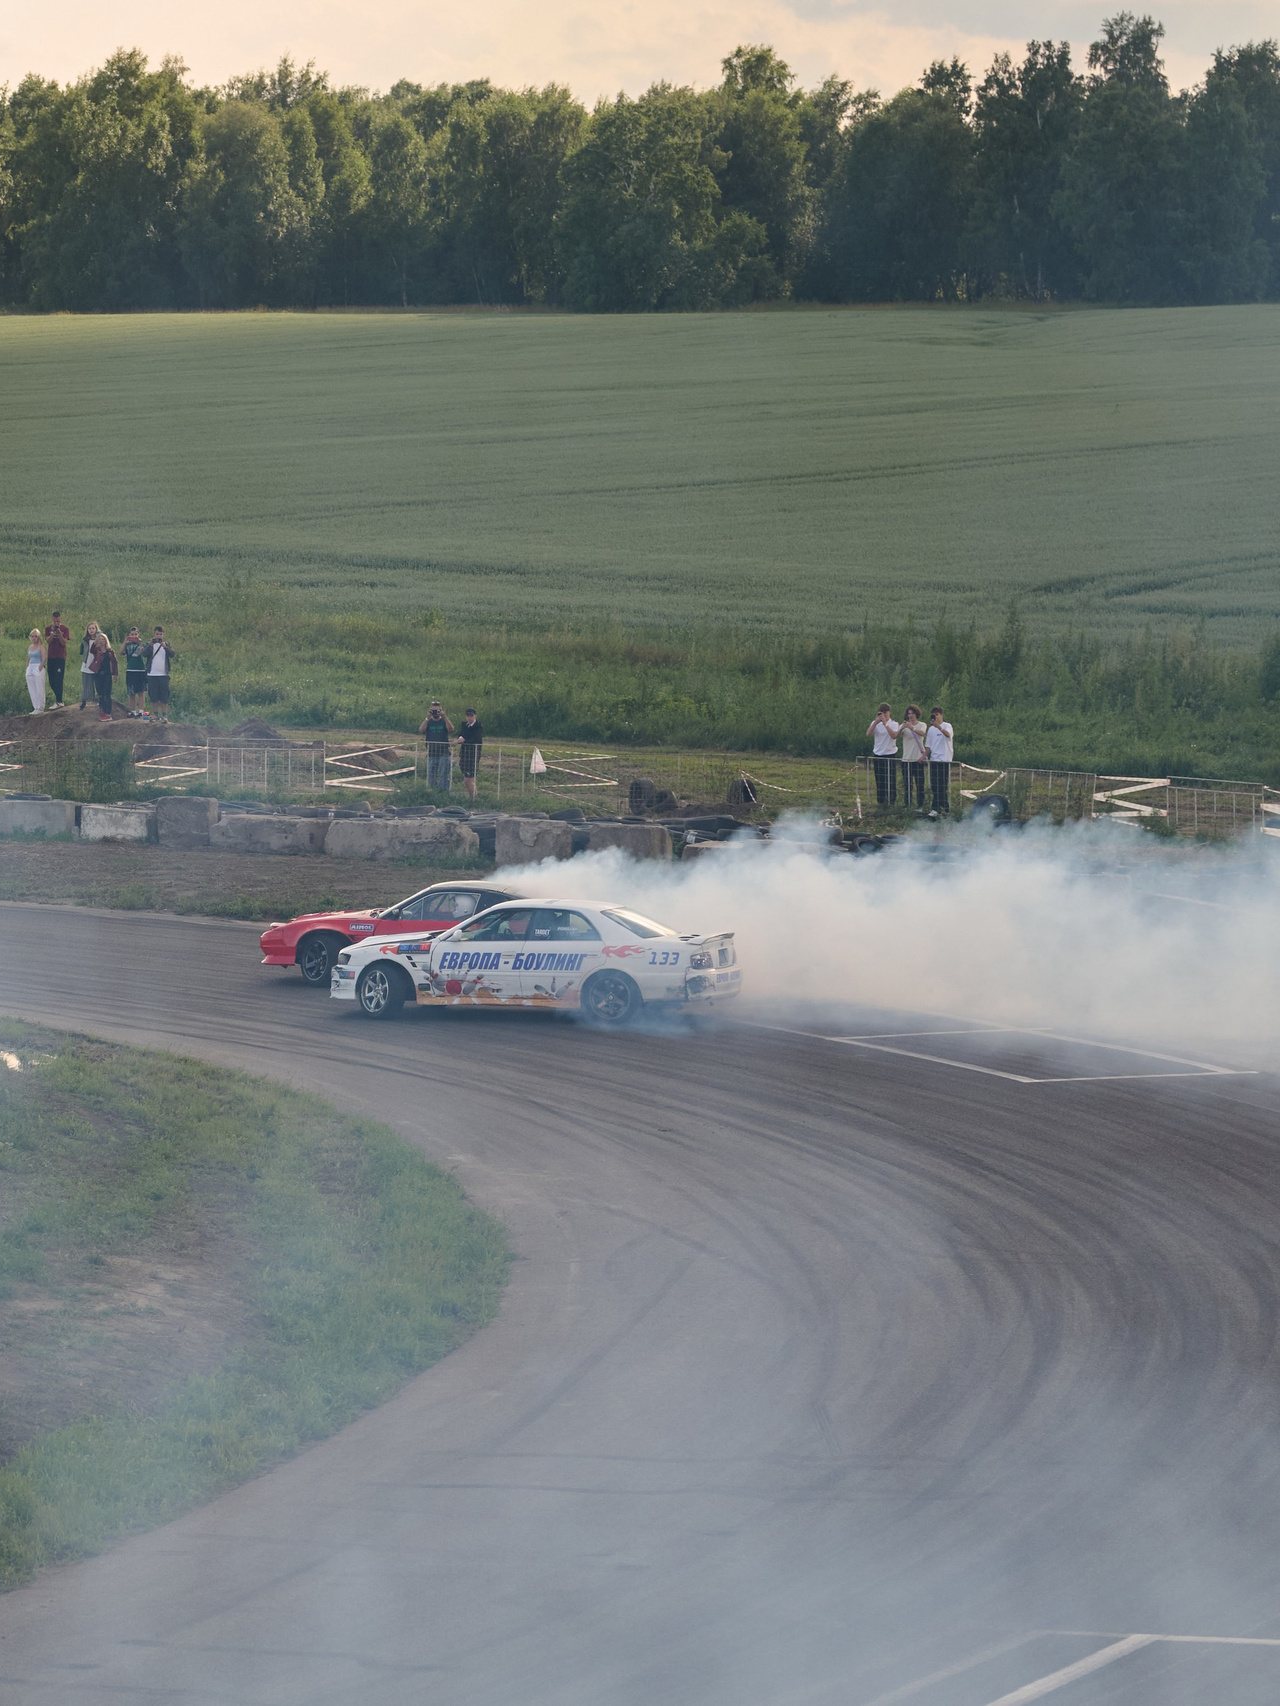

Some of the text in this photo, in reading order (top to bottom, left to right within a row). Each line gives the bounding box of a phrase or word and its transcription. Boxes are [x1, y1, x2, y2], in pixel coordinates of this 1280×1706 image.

[439, 952, 501, 970] ЕВРОПА
[512, 952, 588, 970] БОУЛИНГ
[649, 951, 680, 965] 133
